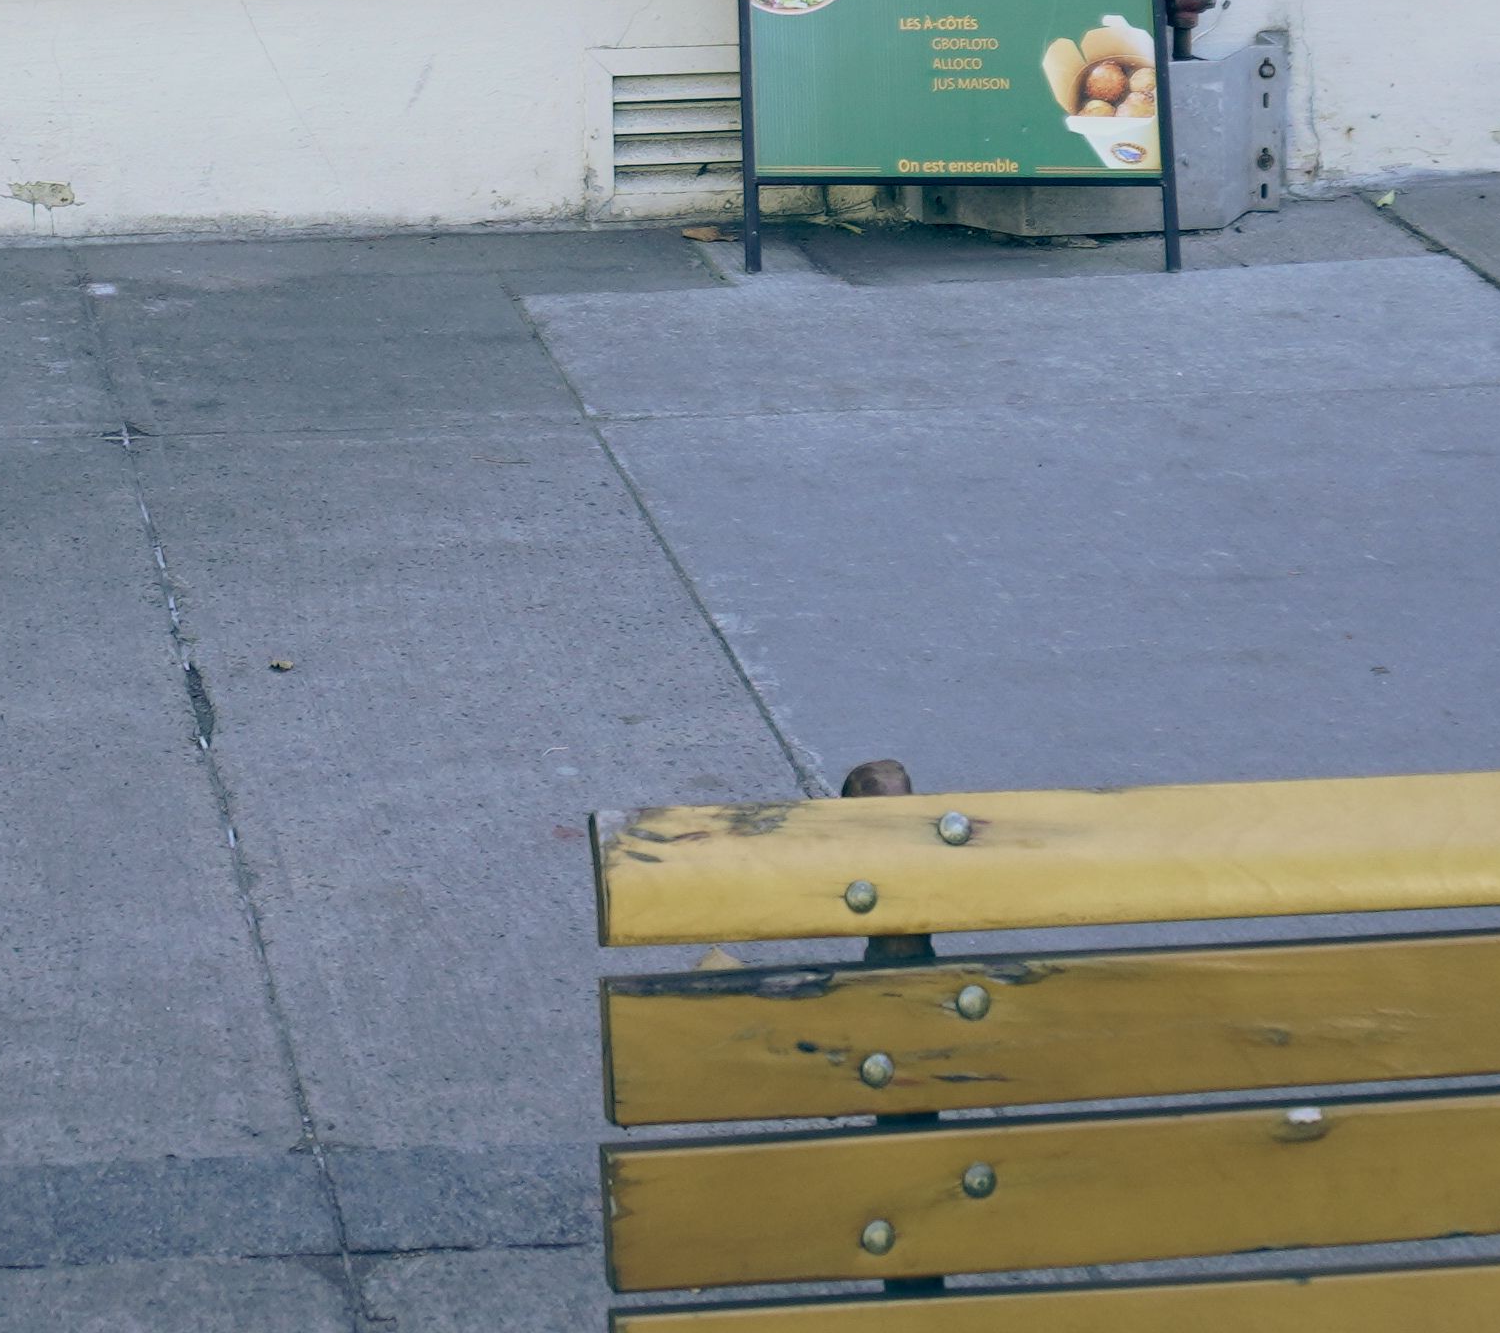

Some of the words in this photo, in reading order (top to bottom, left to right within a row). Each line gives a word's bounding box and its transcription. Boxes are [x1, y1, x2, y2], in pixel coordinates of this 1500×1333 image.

[900, 18, 921, 30] LES
[924, 15, 978, 30] À-CÔTÉS
[932, 38, 998, 50] GBOFLOTO
[933, 58, 982, 70] ALLOCO
[932, 78, 955, 92] JUS
[958, 78, 1010, 89] MAISON
[899, 159, 919, 173] On
[923, 161, 945, 173] est
[949, 158, 1018, 173] ensemble
